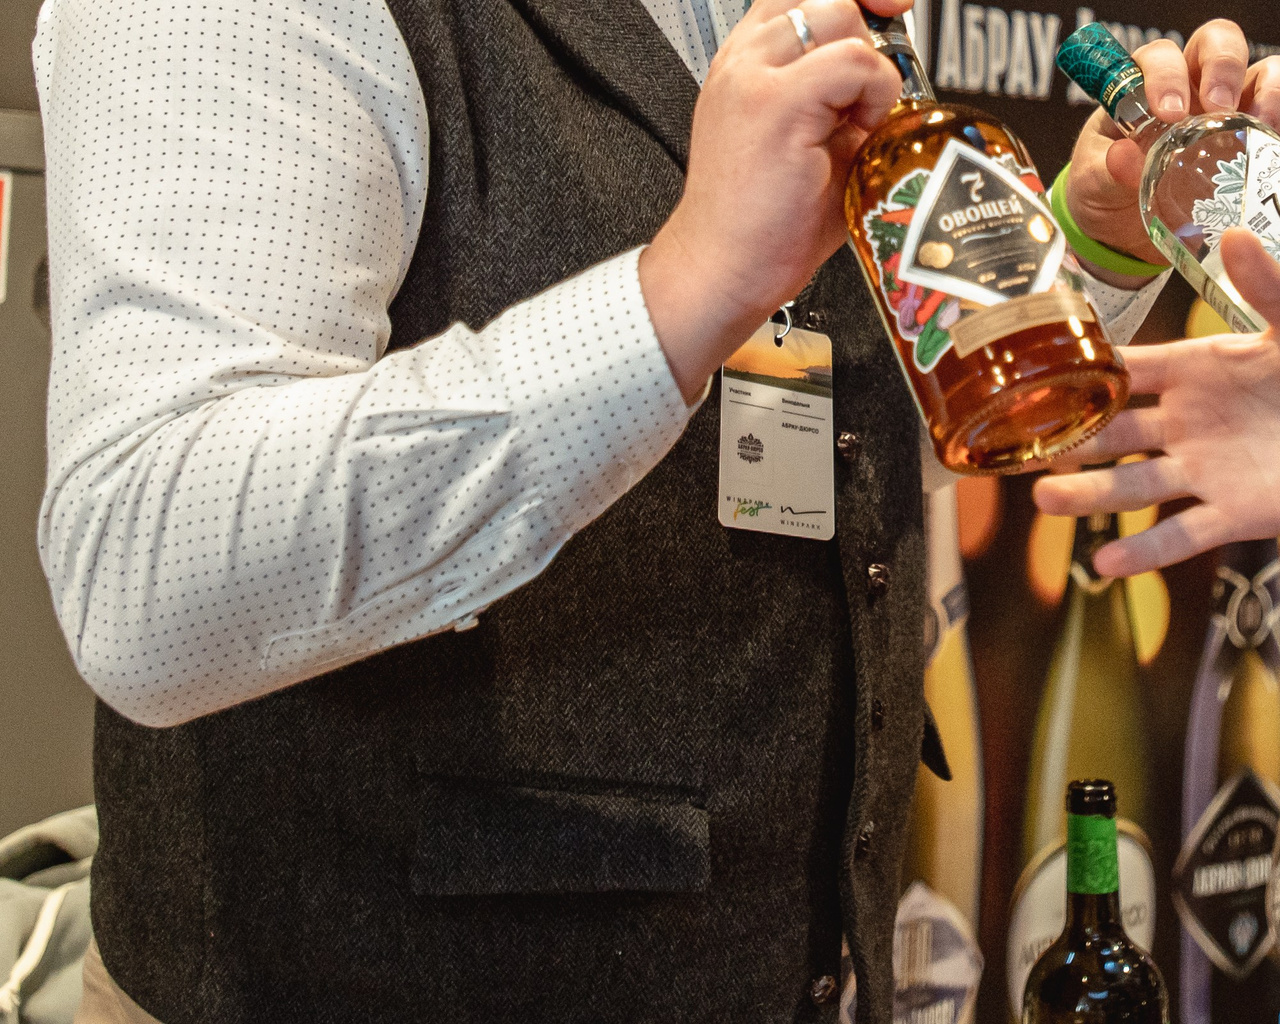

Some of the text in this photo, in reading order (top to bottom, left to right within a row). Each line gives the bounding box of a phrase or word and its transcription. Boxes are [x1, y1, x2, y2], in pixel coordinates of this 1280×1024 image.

[960, 170, 985, 203] 7
[938, 194, 1024, 232] ОВОЩЕЙ
[728, 387, 752, 397] Участник
[781, 422, 820, 435] АБРАУ-ДЮРСО
[733, 501, 772, 522] fest
[780, 519, 821, 531] WINEPARK
